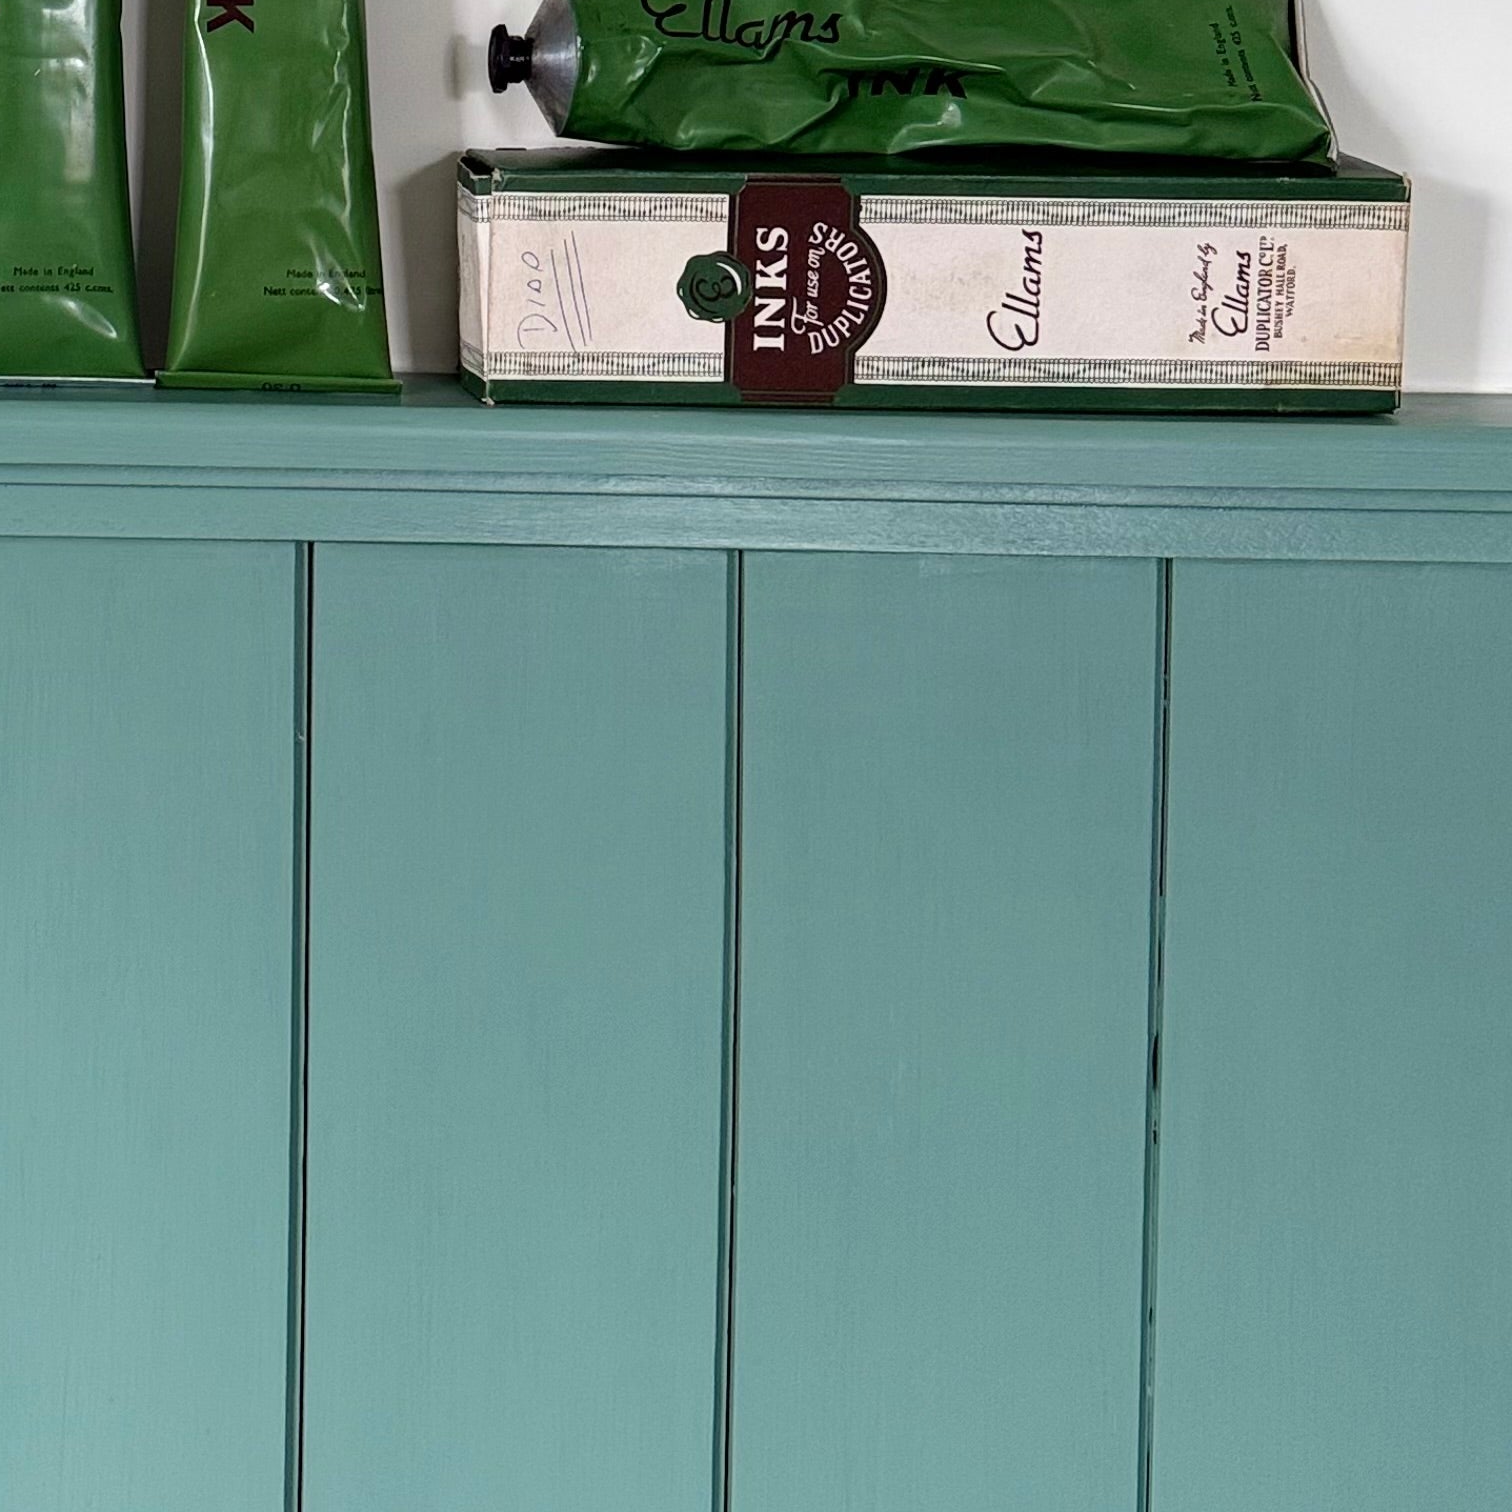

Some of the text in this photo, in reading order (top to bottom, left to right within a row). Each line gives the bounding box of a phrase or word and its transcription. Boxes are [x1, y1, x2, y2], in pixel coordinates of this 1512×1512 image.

[1209, 22, 1226, 55] England
[846, 67, 968, 100] INK
[13, 265, 94, 278] Made in England
[19, 284, 60, 293] contents
[64, 282, 81, 292] 425
[286, 269, 313, 279] Made
[753, 227, 789, 352] INKS
[791, 246, 826, 335] For use on
[807, 221, 873, 356] DUPLICATORS
[986, 228, 1043, 352] Ellams
[1274, 272, 1286, 296] HALL
[263, 286, 287, 297] Nett
[1187, 242, 1218, 344] Made in England by
[1210, 250, 1251, 338] Ellams
[1254, 269, 1273, 353] DUPLICATOR
[1273, 300, 1285, 339] BUSHEY
